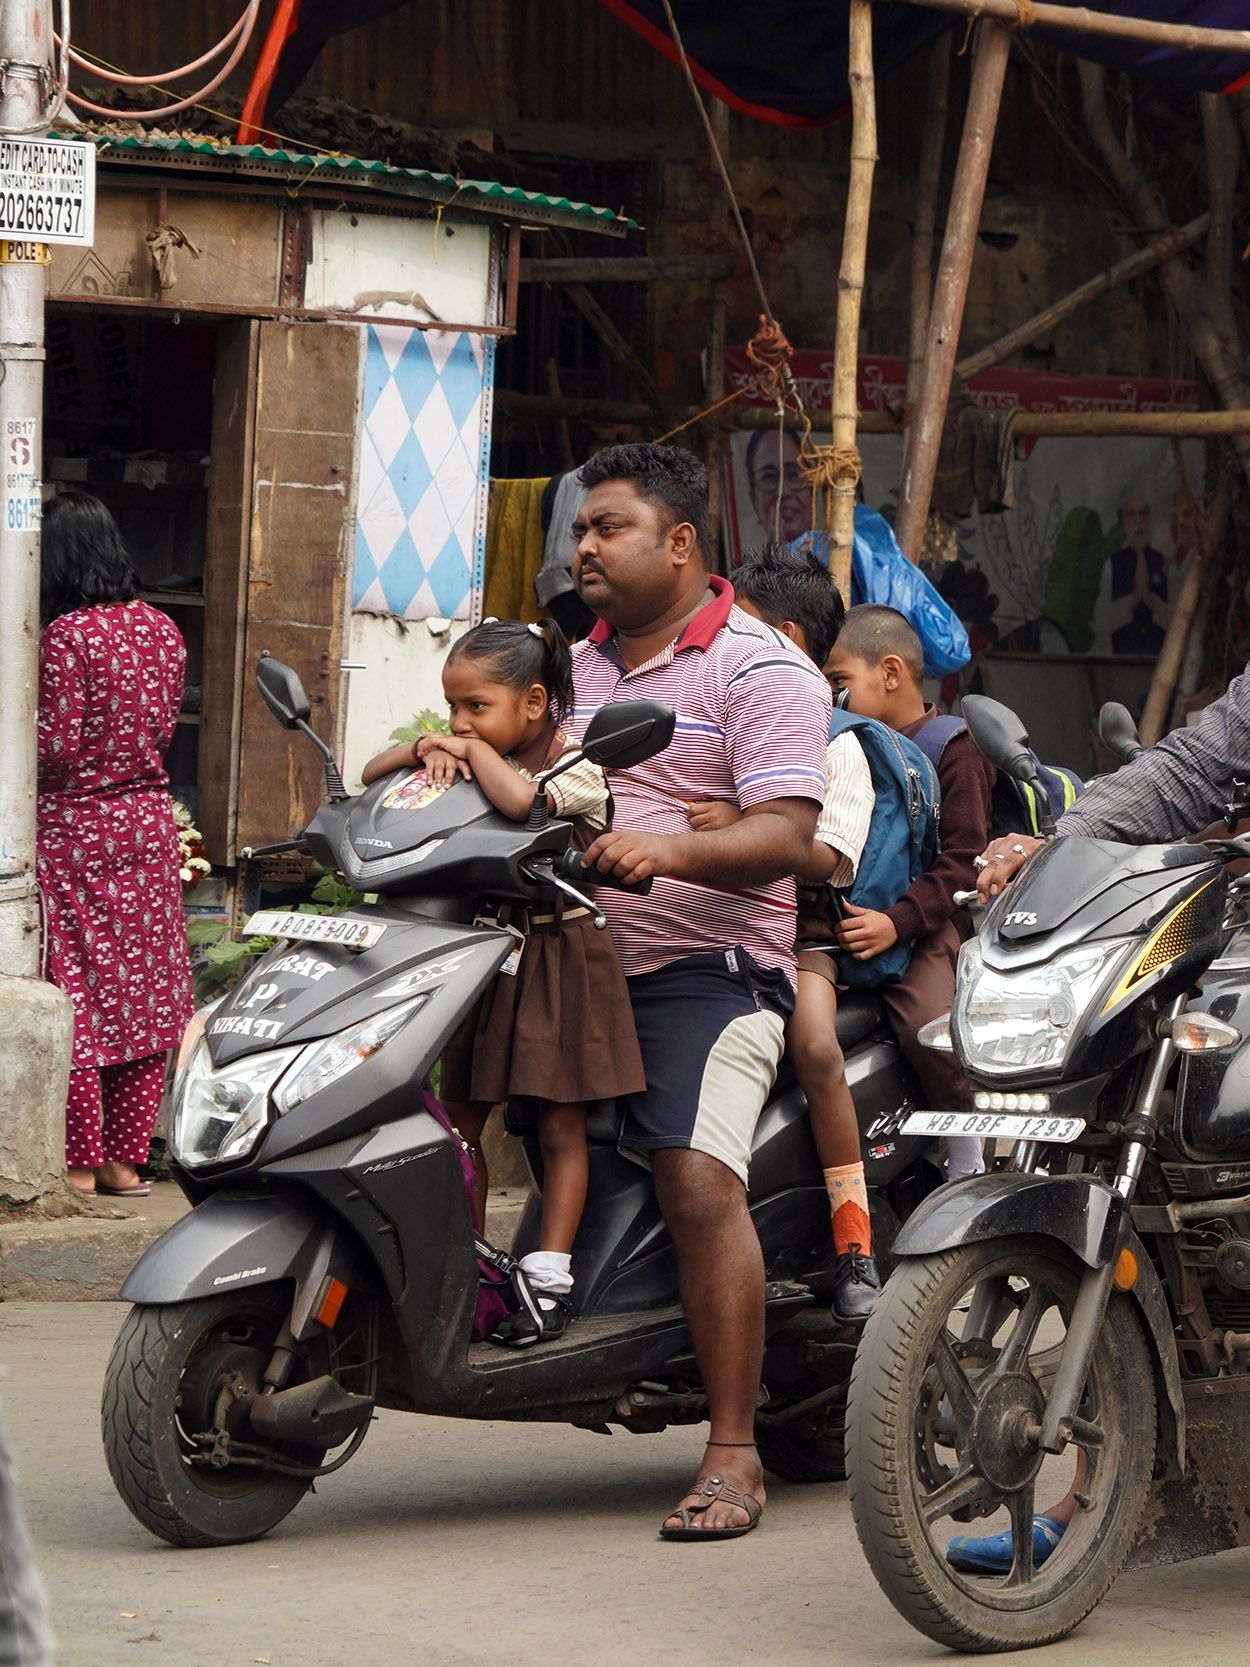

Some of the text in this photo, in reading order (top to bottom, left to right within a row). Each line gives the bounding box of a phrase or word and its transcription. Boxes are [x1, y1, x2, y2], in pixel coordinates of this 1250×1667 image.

[22, 145, 83, 176] CARD-TO-CASH
[1, 173, 27, 189] INSTANT
[29, 176, 45, 191] CASH
[46, 178, 53, 191] IN
[60, 178, 83, 194] MINUTE
[0, 191, 82, 233] 202663737
[8, 242, 36, 260] POLE
[98, 315, 139, 418] OREX
[355, 836, 393, 849] HONDA
[1004, 911, 1038, 927] TVS
[927, 1114, 1075, 1138] WB 08F 1293
[241, 1266, 267, 1279] Brake
